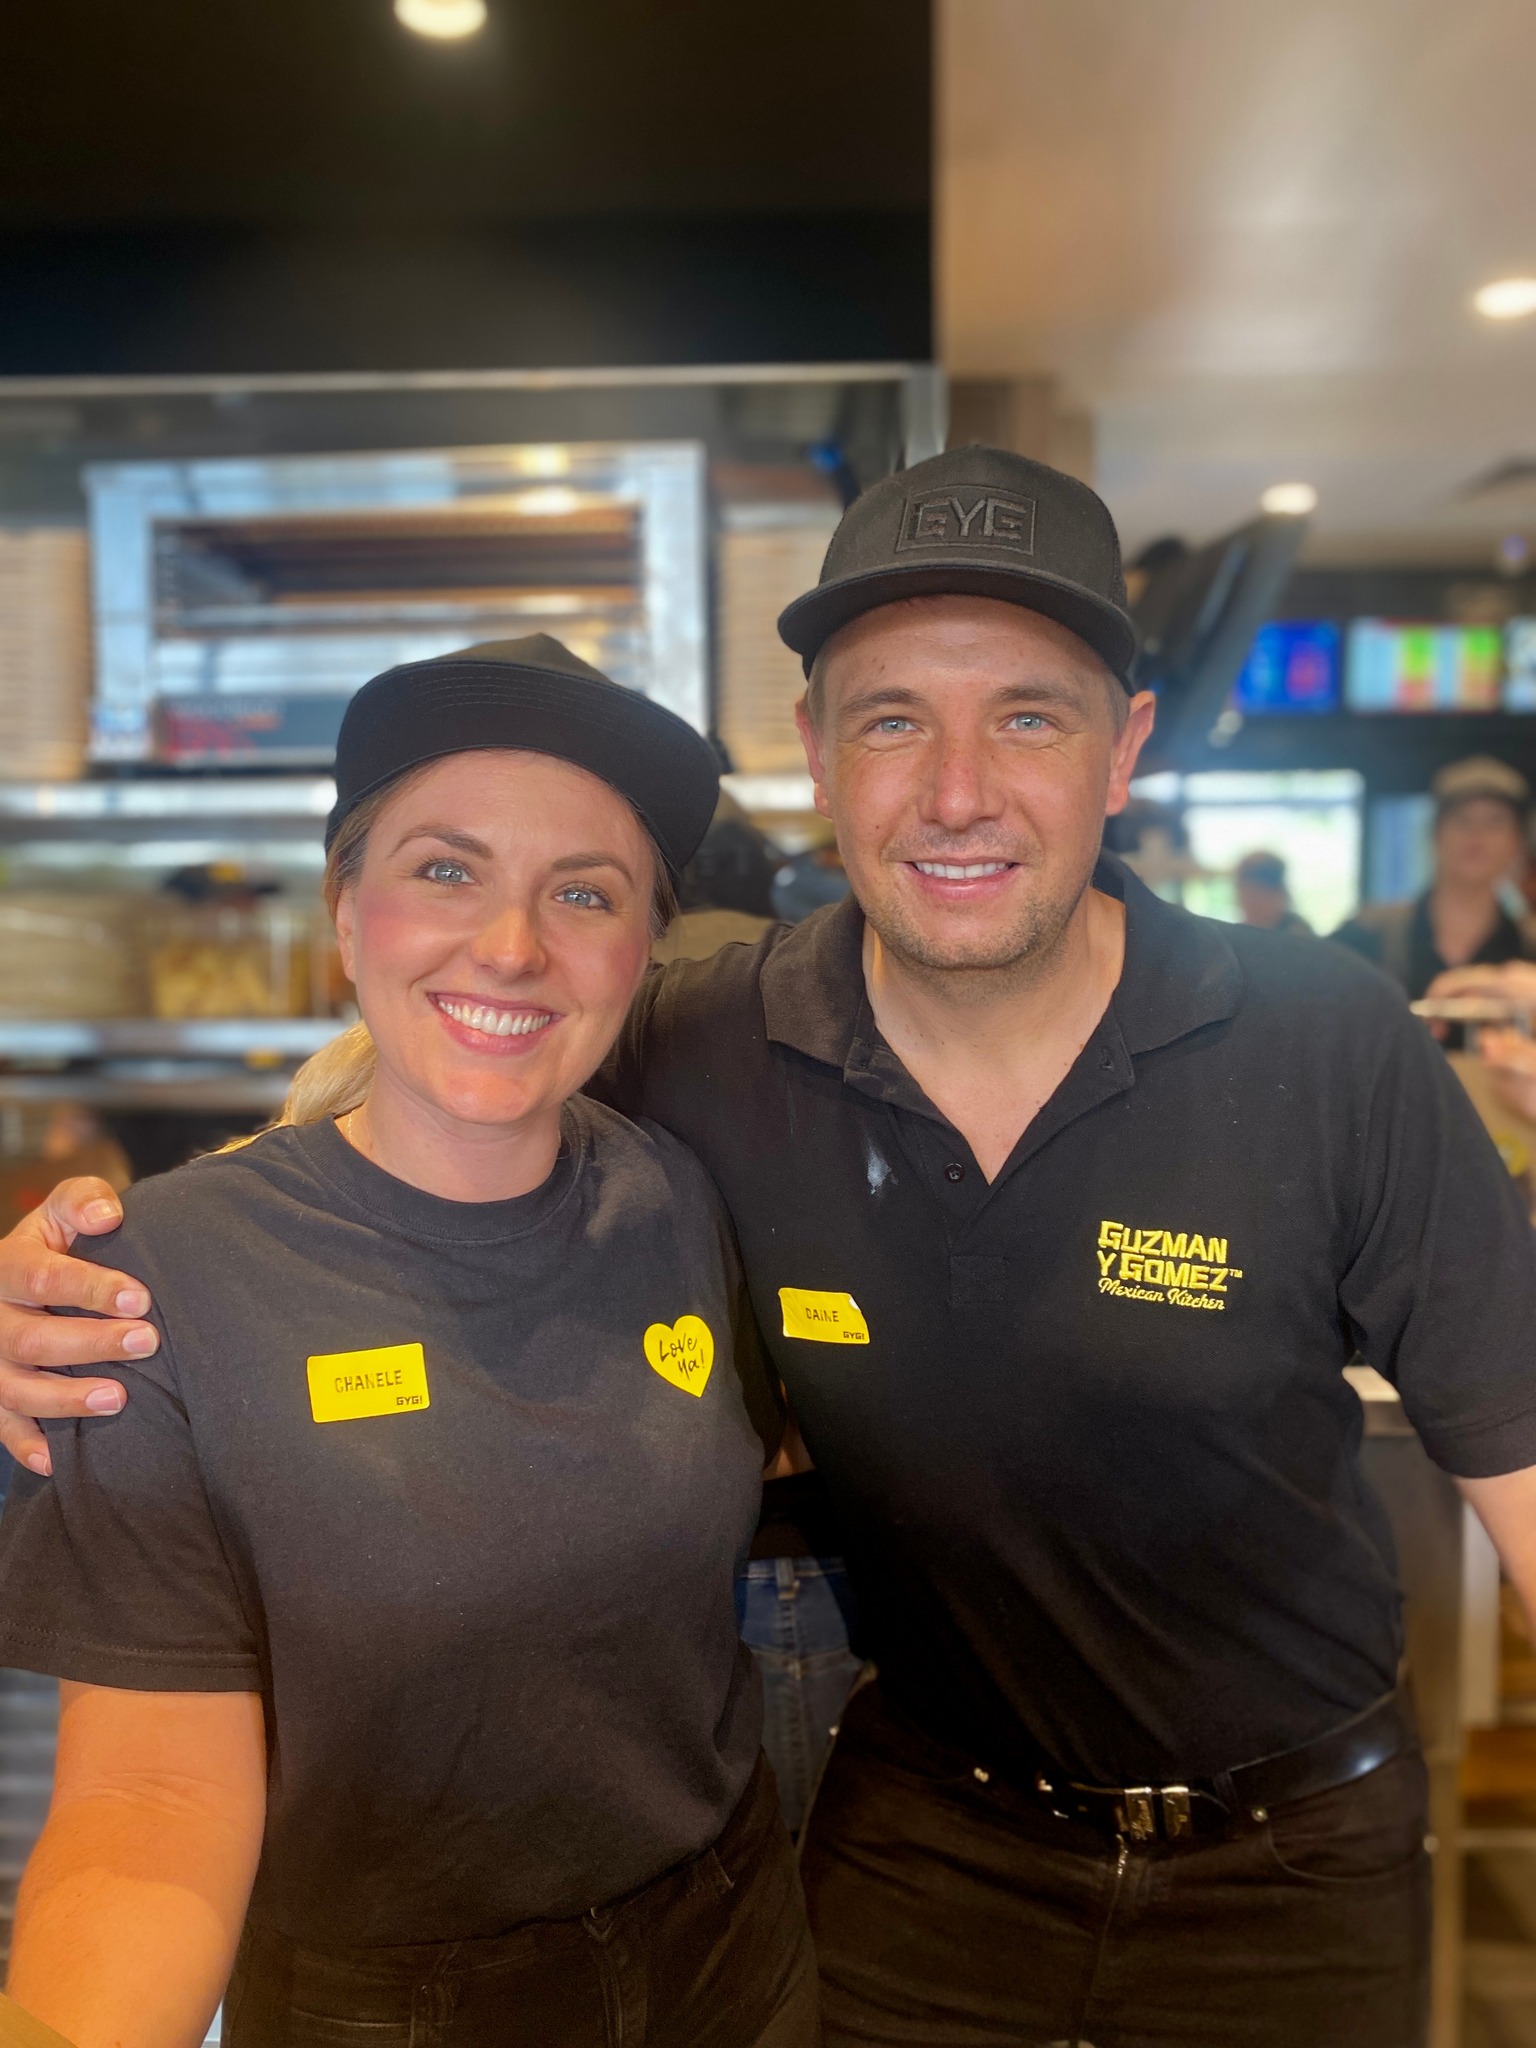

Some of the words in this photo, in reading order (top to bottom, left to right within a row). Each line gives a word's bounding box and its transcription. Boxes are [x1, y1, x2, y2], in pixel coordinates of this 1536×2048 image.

[908, 497, 1026, 541] GYG
[1098, 1220, 1228, 1264] GUZMAN
[1097, 1250, 1117, 1276] Y
[1098, 1277, 1164, 1302] Mexican
[1167, 1288, 1225, 1310] Kitchen
[659, 1333, 697, 1362] Love
[334, 1369, 402, 1393] CHANELE
